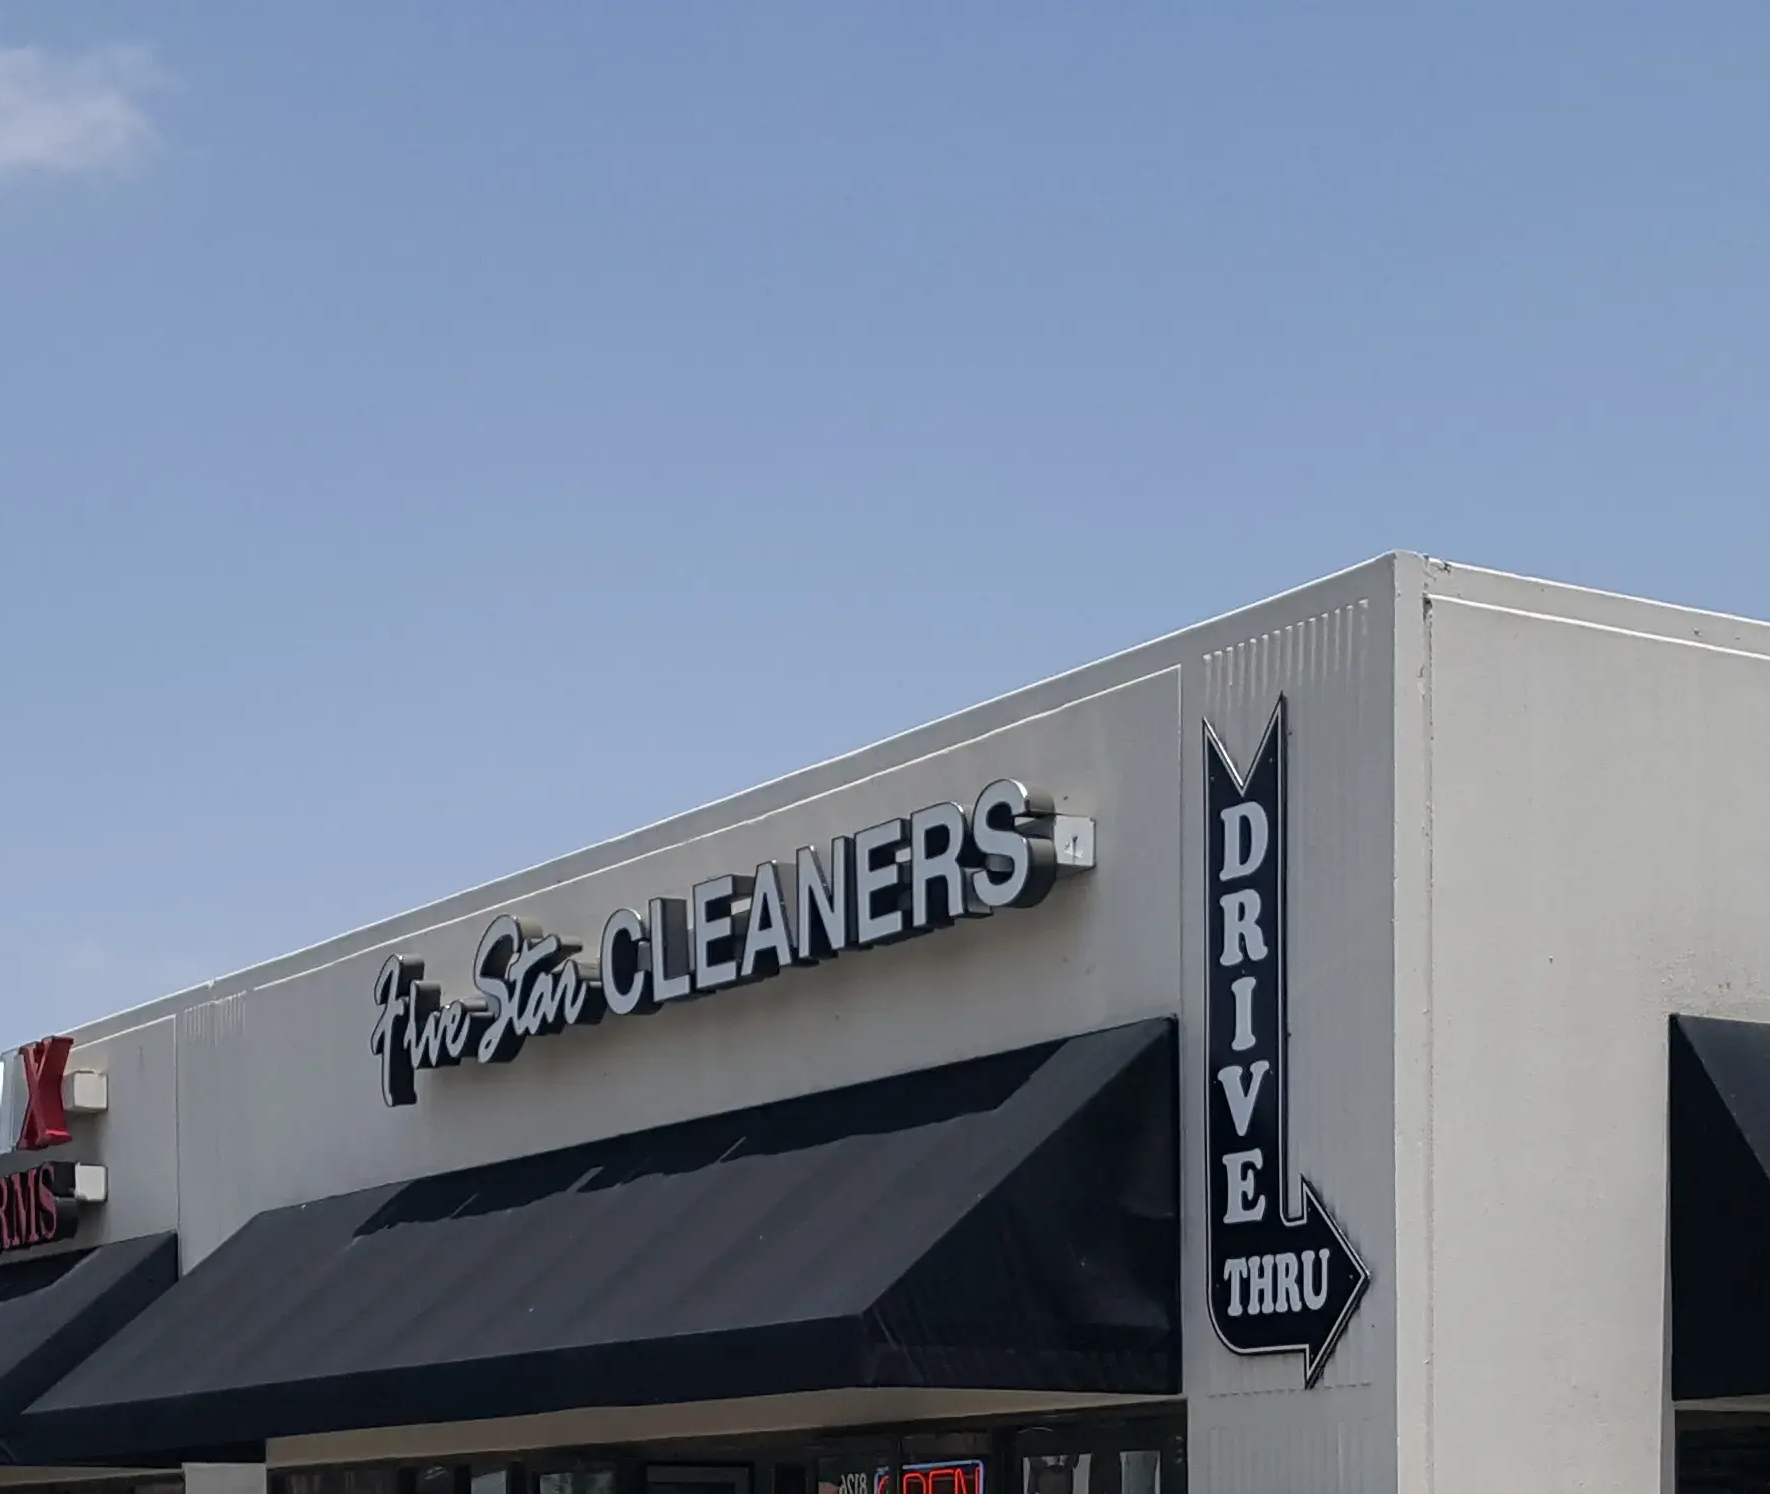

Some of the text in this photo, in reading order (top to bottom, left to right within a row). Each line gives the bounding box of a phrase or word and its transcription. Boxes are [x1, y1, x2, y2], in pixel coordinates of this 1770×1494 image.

[371, 778, 1041, 1107] Five Star CLEANERS
[1217, 801, 1270, 1224] DRIVE
[1224, 1248, 1331, 1318] THRU
